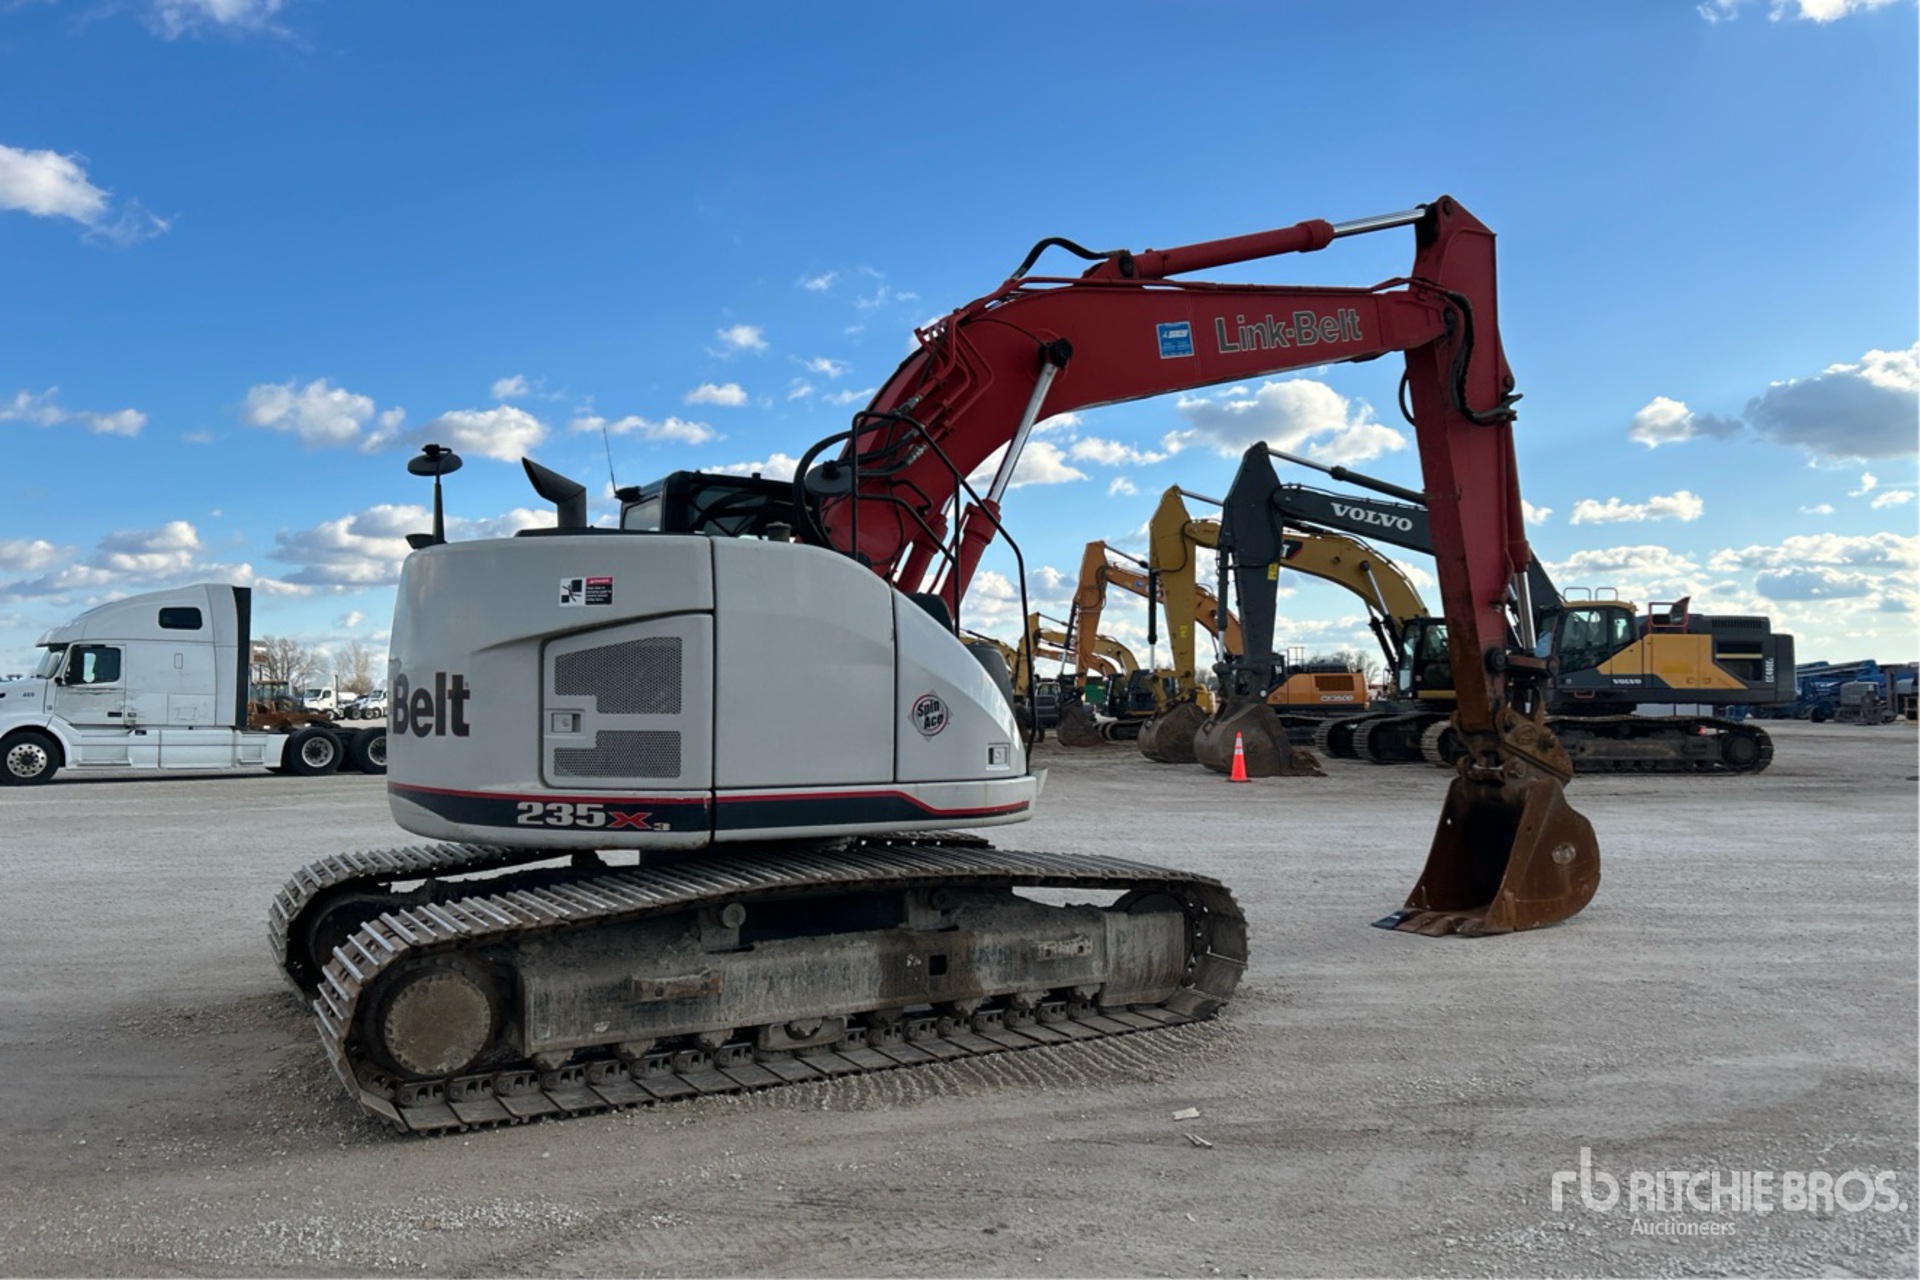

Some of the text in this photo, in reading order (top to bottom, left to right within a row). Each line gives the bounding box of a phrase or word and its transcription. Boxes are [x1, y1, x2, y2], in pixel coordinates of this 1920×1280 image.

[1214, 308, 1363, 354] Link-Belt
[1330, 502, 1413, 532] VOLVO
[917, 699, 940, 717] Spin
[923, 713, 944, 730] Ace
